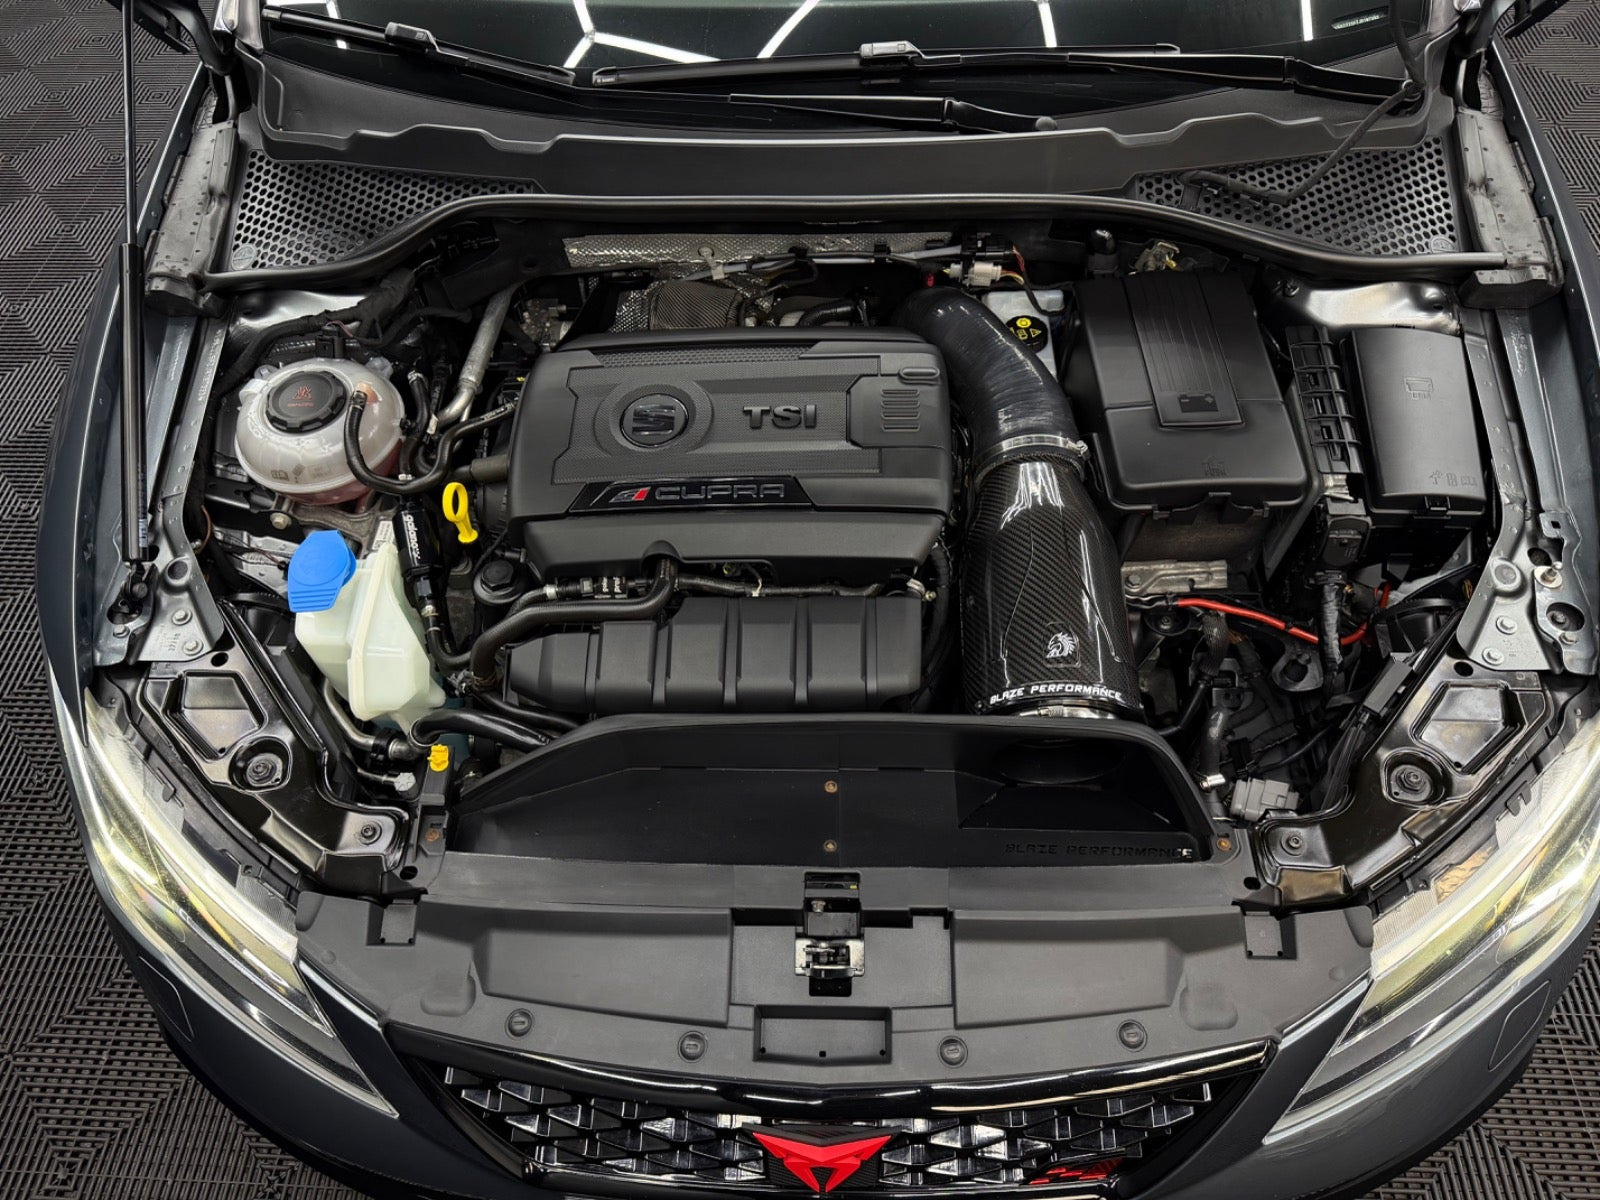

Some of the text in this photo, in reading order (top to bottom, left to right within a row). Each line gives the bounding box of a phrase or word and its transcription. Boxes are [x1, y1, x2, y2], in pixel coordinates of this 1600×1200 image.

[743, 404, 817, 429] TSI
[655, 484, 784, 500] CUPRA
[990, 683, 1123, 705] BLAZE PERFORMANCE
